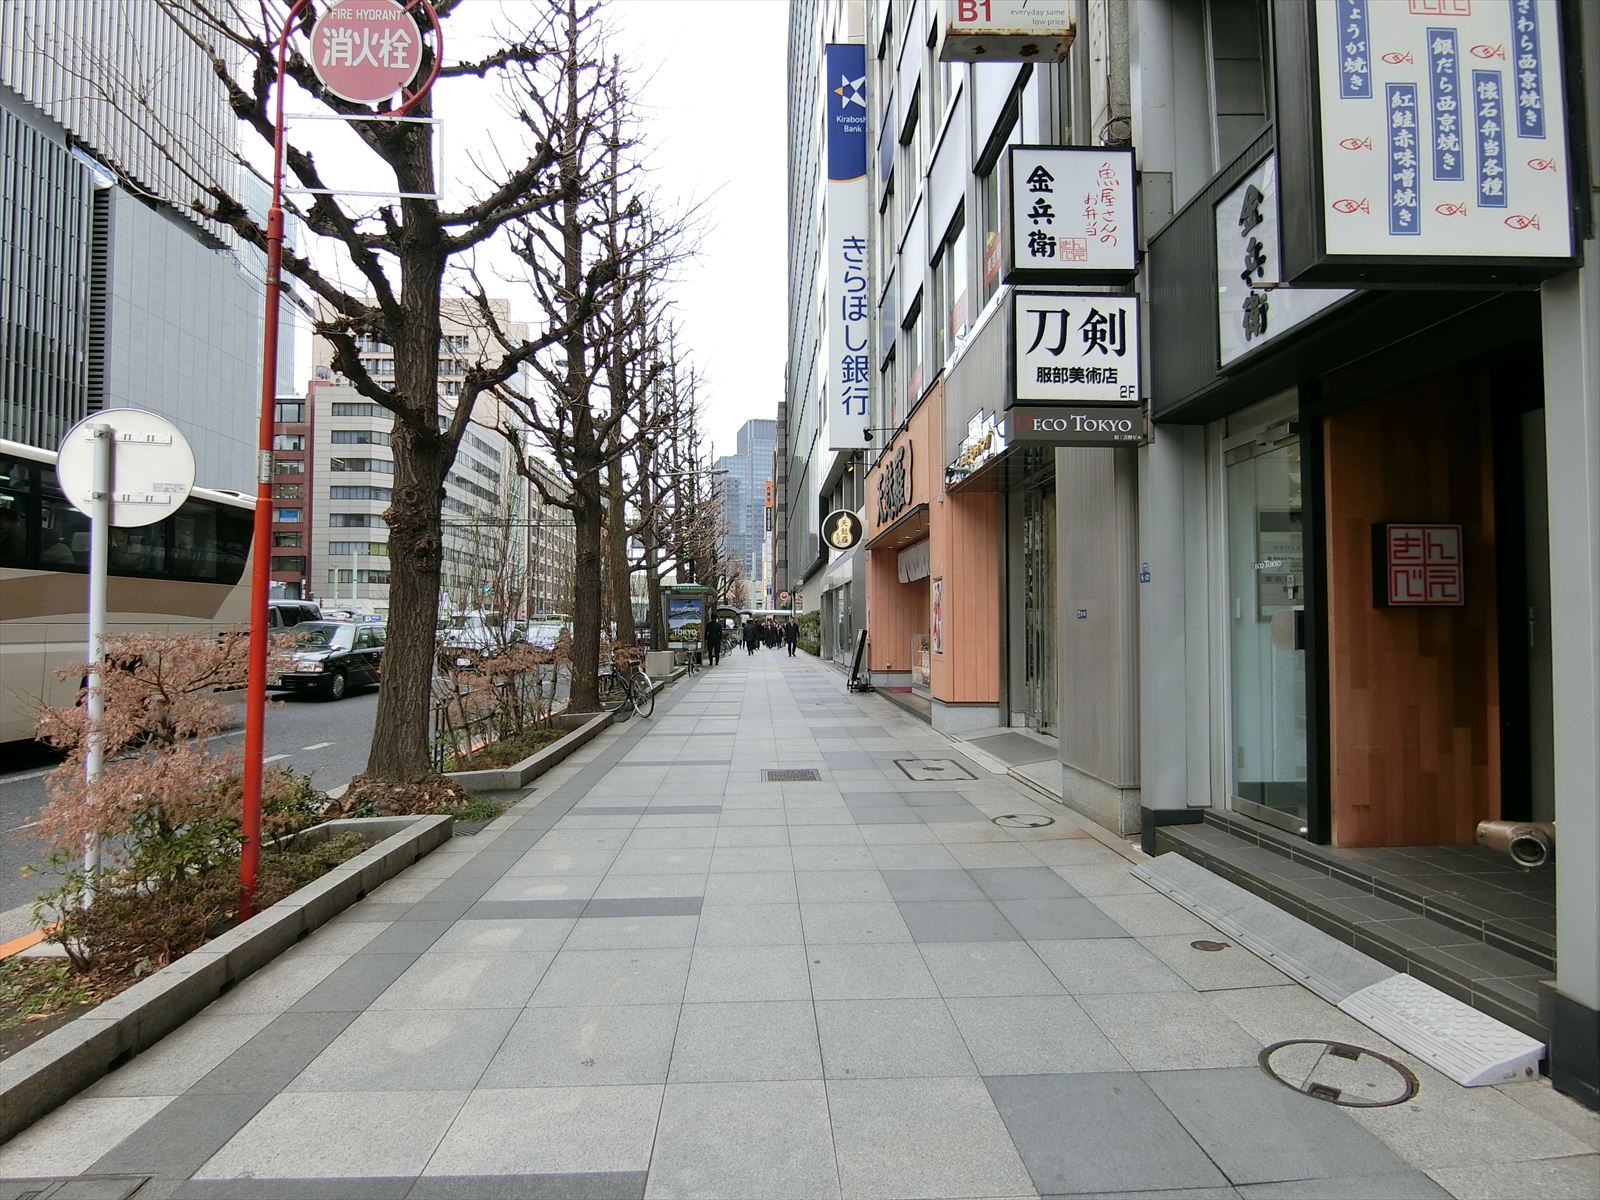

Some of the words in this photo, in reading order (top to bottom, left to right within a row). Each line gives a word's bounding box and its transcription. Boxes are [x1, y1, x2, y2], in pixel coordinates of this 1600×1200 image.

[331, 8, 352, 20] FIRE
[356, 9, 402, 21] HYDRANT
[958, 0, 991, 22] B1
[1010, 9, 1044, 17] everyday
[1047, 18, 1066, 26] price
[322, 27, 412, 69] 消火栓
[1344, 0, 1368, 91] ょうが焼き
[1516, 0, 1542, 127] さわら西京焼き
[1431, 37, 1460, 171] 銀だら西京焼き
[843, 125, 862, 133] Bank
[1477, 81, 1504, 196] 懐石弁当各種
[1391, 90, 1417, 227] 紅鮭赤味噌焼き
[1026, 165, 1057, 258] 金兵衛
[1082, 192, 1099, 237] お弁当
[1097, 162, 1120, 247] 魚屋さんの
[841, 235, 869, 416] きらぼし銀行
[1025, 307, 1127, 358] 刀剣
[1036, 366, 1118, 384] 服部美術店
[1119, 385, 1136, 399] 2F
